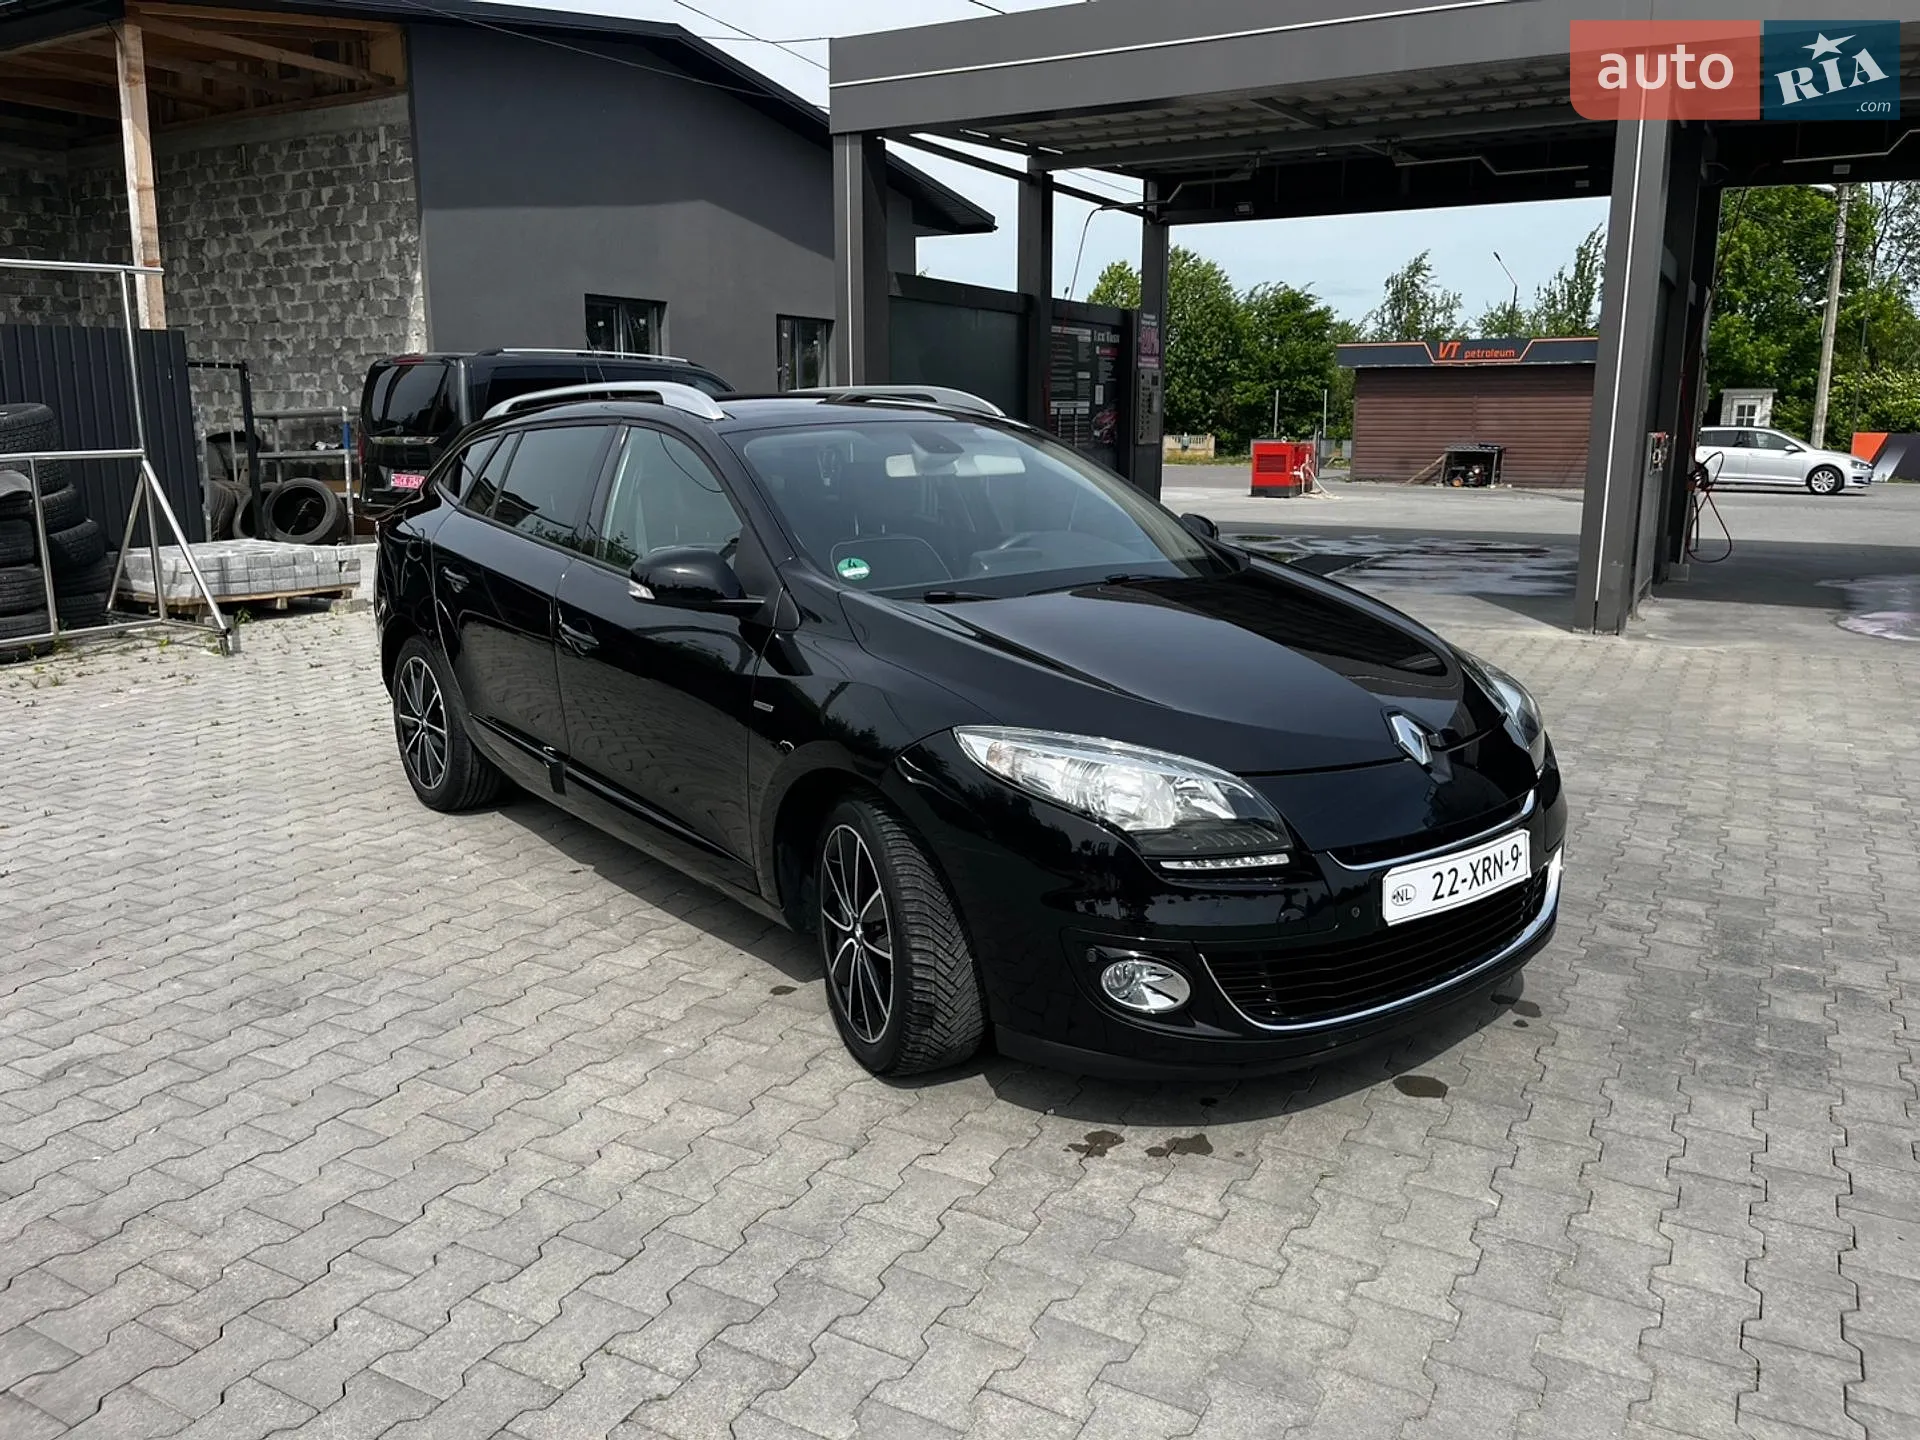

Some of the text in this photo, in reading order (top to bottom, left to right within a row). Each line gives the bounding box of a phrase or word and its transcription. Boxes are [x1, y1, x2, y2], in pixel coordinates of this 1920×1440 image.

[1438, 341, 1515, 359] VT petroleum
[1396, 843, 1519, 902] NL 22-XRN-9
